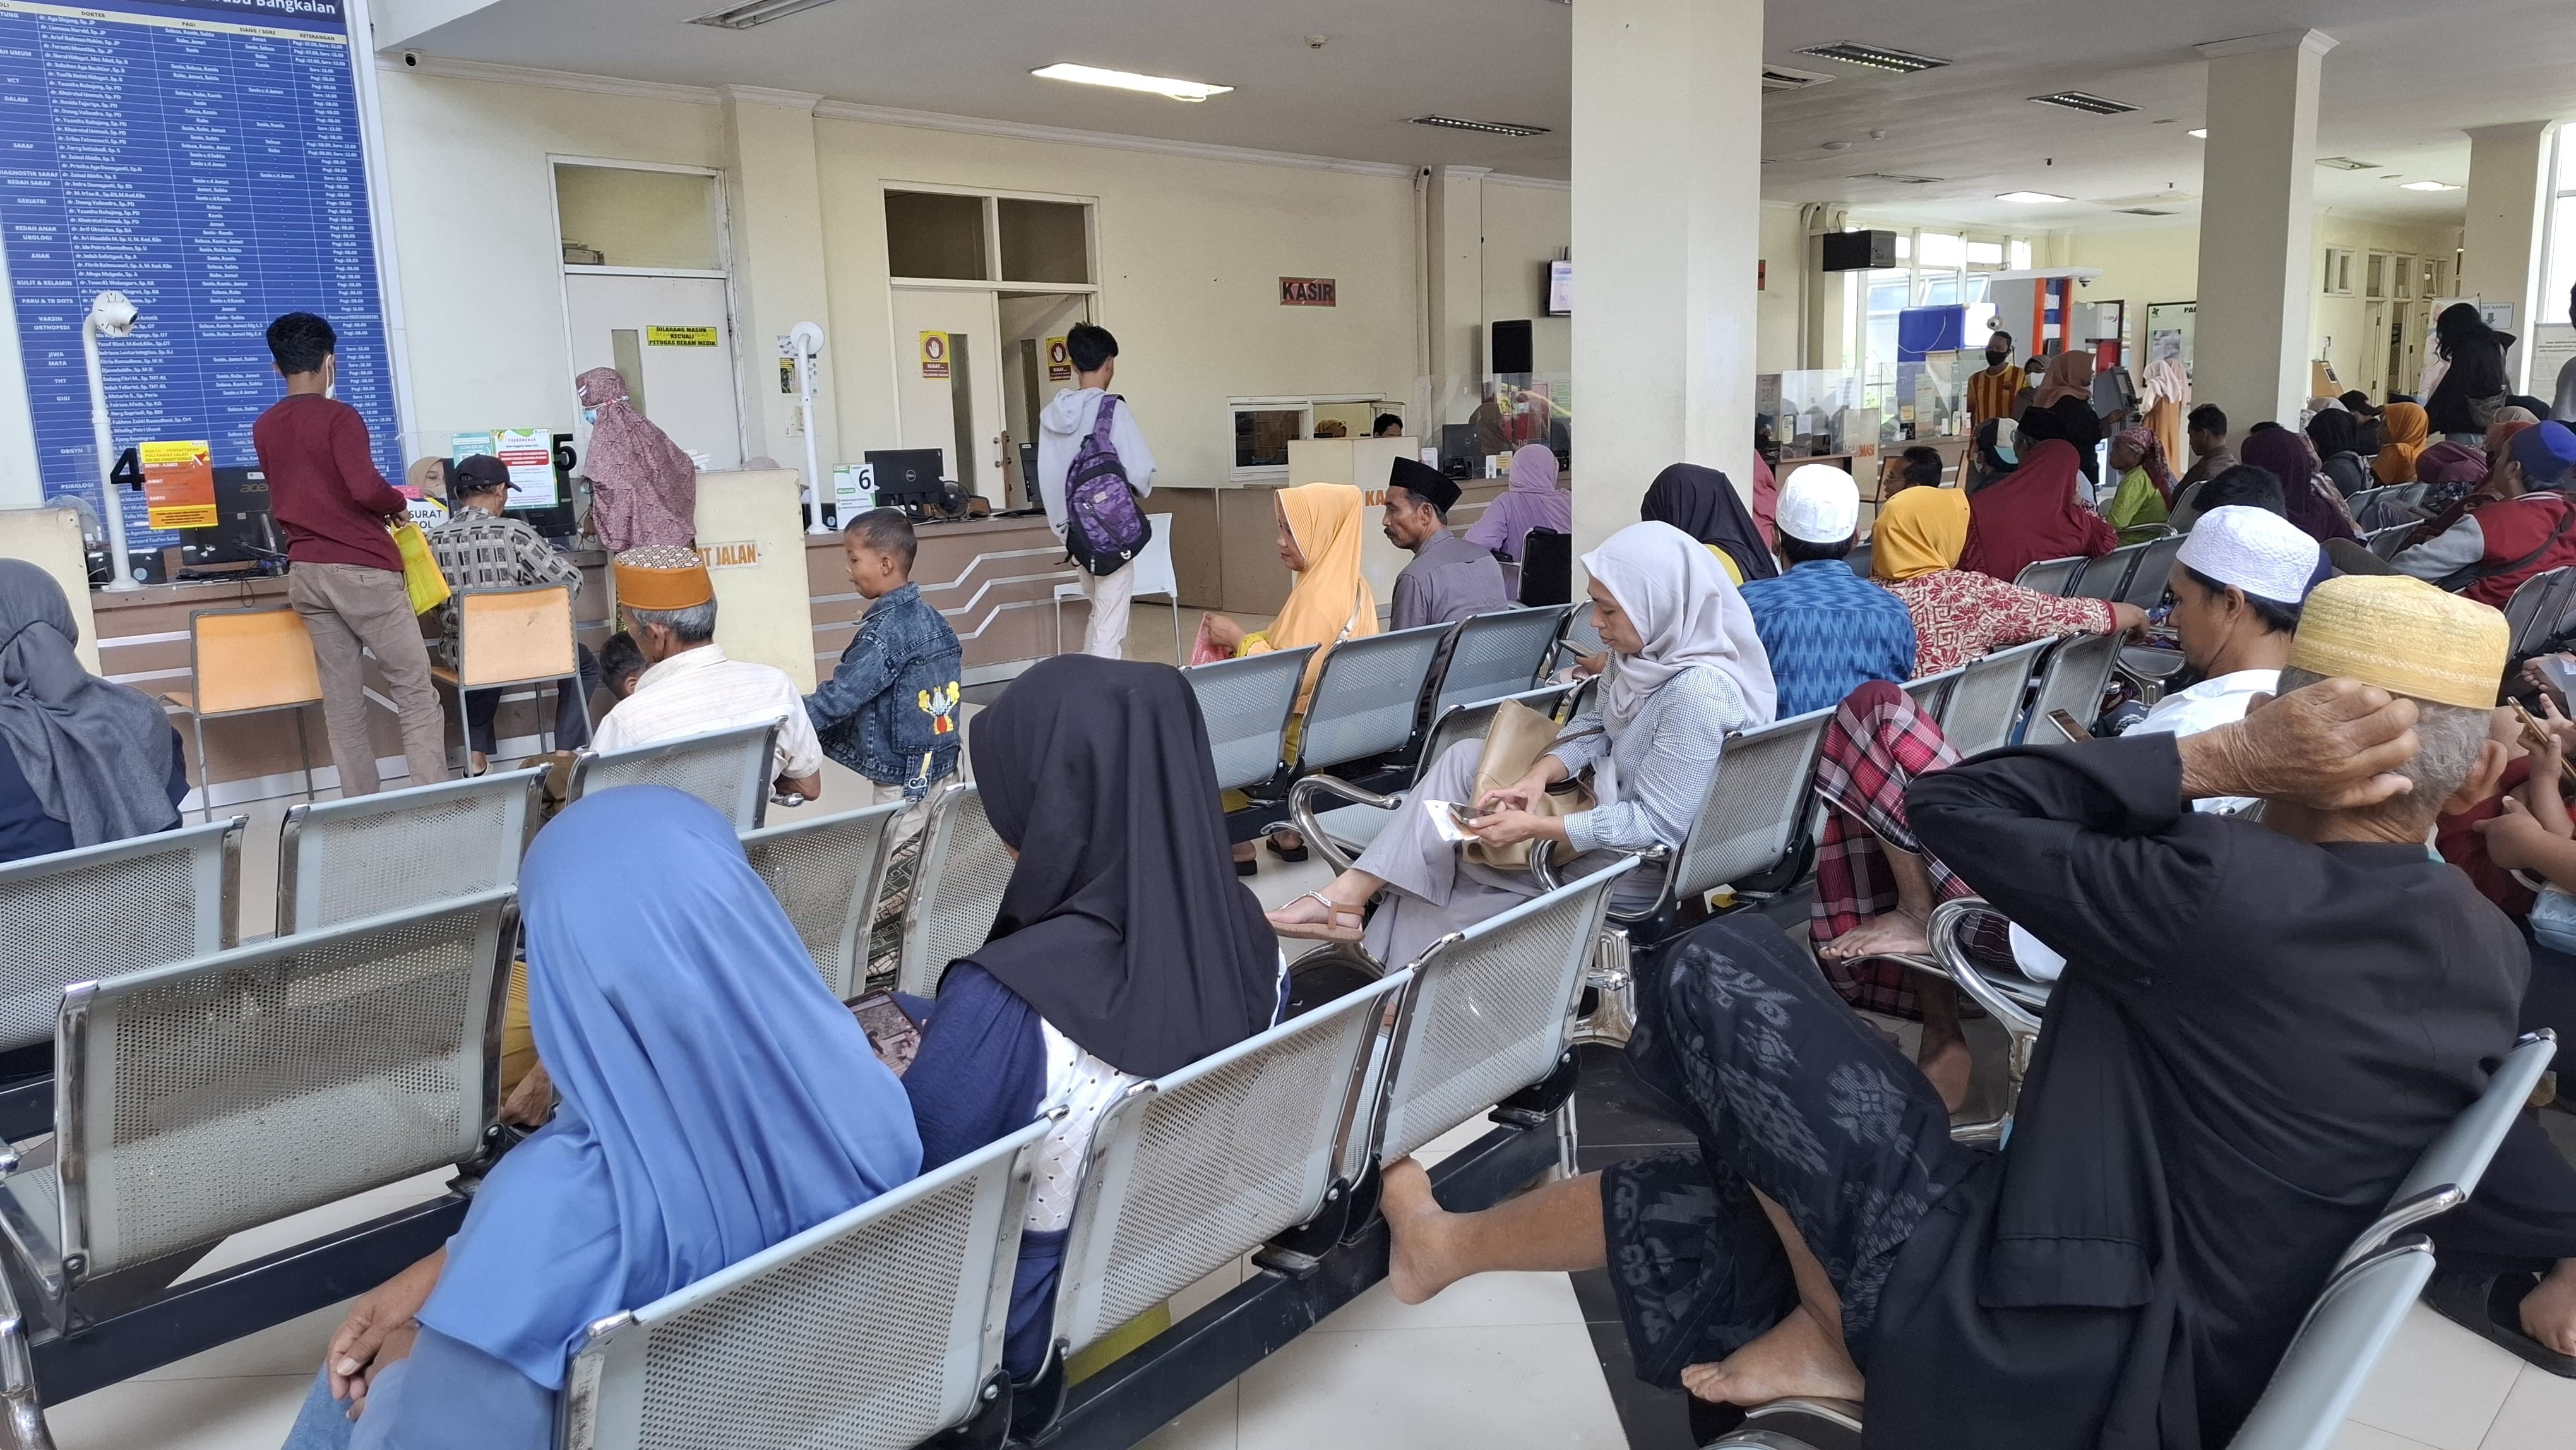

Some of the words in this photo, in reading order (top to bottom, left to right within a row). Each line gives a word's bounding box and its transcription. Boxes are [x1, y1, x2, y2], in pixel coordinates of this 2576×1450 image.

[257, 0, 335, 14] Bangkalan
[1282, 282, 1333, 301] KASIR
[553, 433, 577, 471] 5
[110, 447, 146, 491] 4
[240, 483, 268, 493] ace
[859, 469, 871, 490] 6
[409, 510, 442, 518] SURAT
[716, 544, 757, 566] JALAN
